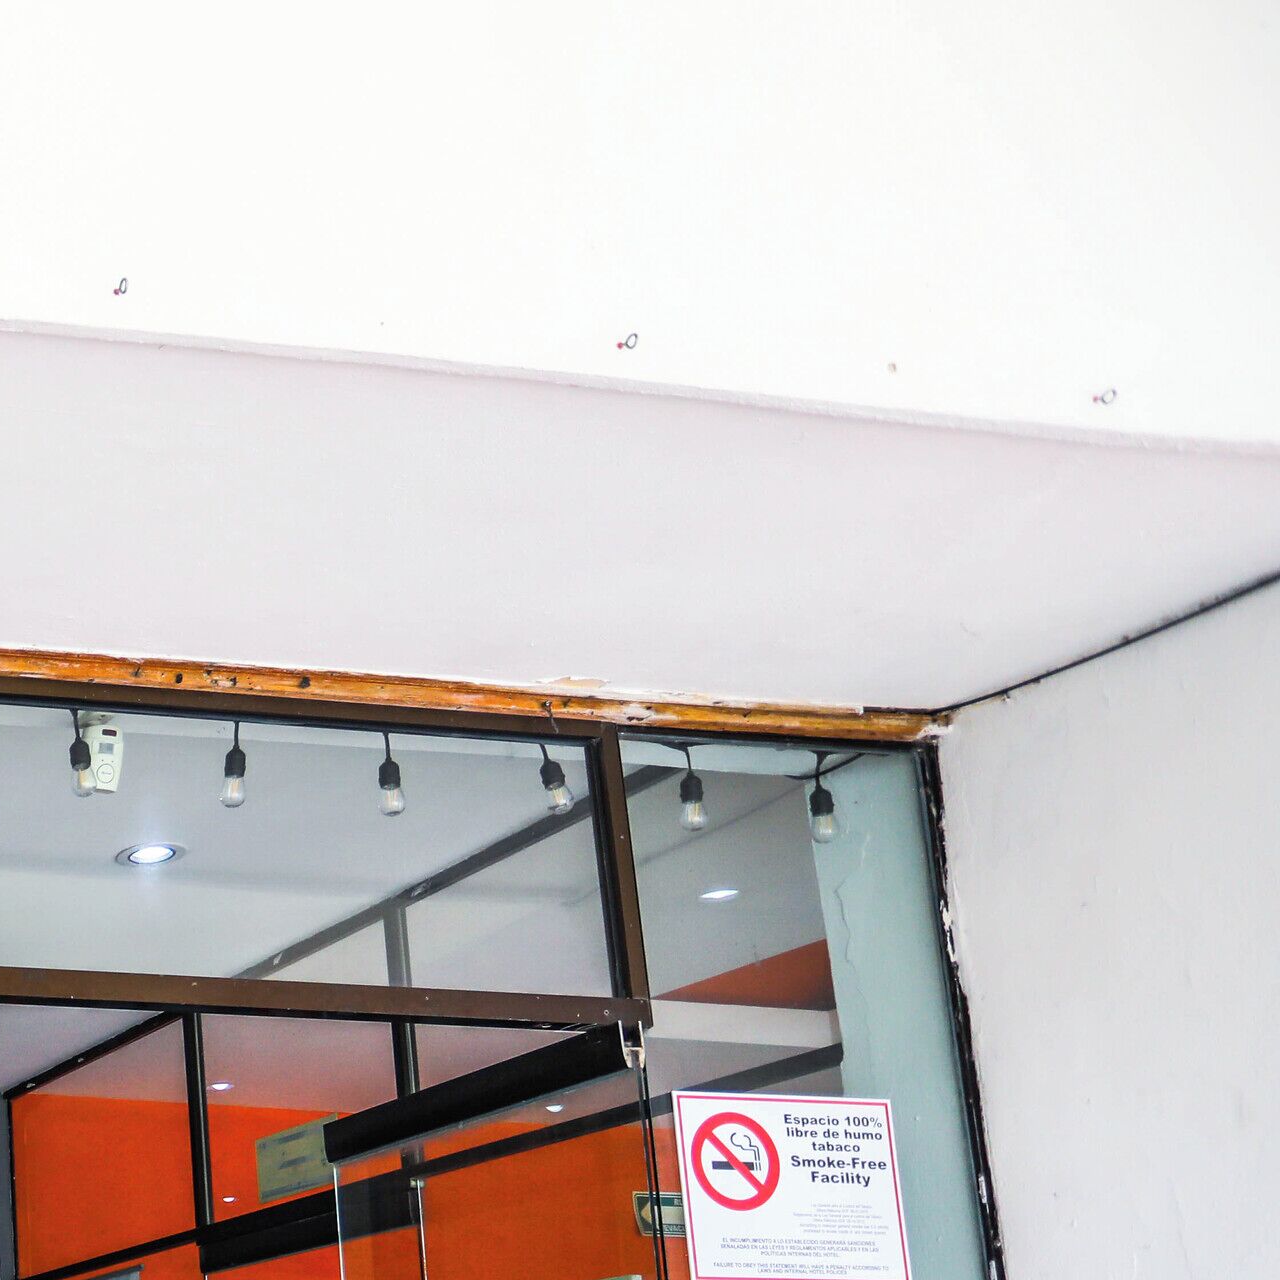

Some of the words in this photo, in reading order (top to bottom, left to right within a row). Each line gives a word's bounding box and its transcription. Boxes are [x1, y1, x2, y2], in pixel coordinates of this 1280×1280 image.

[784, 1114, 839, 1127] Espacio
[844, 1116, 882, 1128] 100%
[786, 1127, 818, 1138] libre
[823, 1129, 839, 1139] de
[844, 1129, 882, 1140] humo
[812, 1141, 860, 1152] tabaco
[791, 1155, 887, 1170] Smoke-Free
[811, 1171, 870, 1187] Facility
